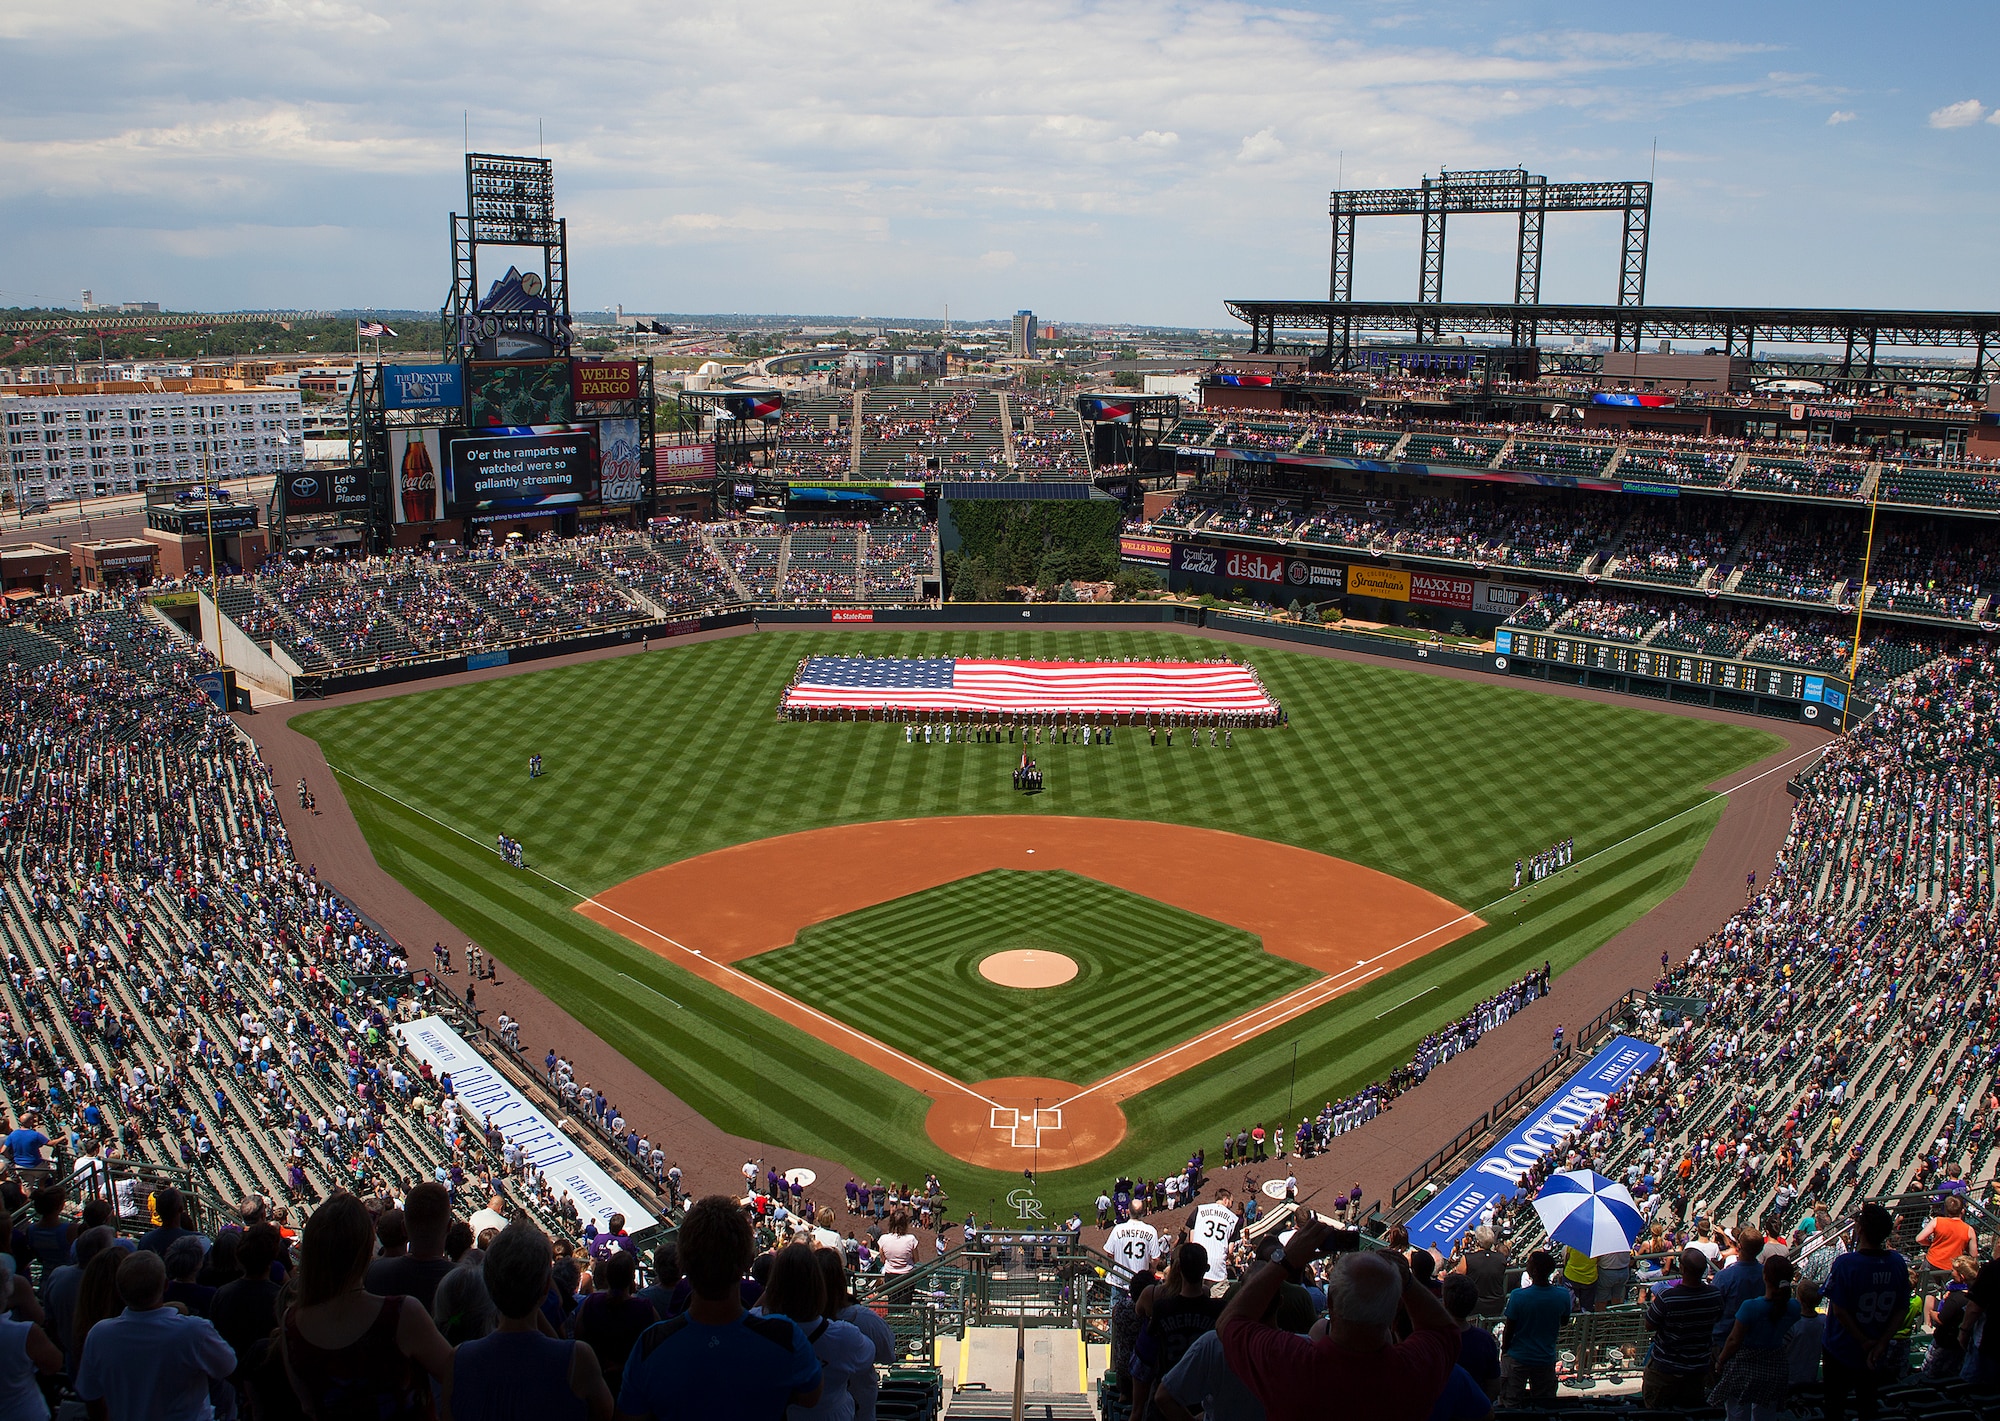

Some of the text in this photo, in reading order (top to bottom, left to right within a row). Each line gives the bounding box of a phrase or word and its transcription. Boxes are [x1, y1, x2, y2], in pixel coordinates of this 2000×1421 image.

[458, 313, 574, 347] ROCKIES
[1360, 352, 1476, 370] THE ROOFTOP
[394, 372, 453, 384] THE DENVER
[581, 368, 630, 380] WELLS
[401, 382, 442, 398] POST
[581, 382, 630, 394] FARGO
[1807, 407, 1852, 419] TAVERN
[467, 446, 577, 461] O'er the ramparts we
[667, 448, 704, 465] KING
[480, 461, 566, 474] watched were so
[334, 475, 356, 484] Let's
[475, 473, 572, 492] gallantly streaming
[189, 492, 217, 500] TOYOTA
[334, 485, 348, 494] Go
[602, 481, 642, 500] LIGHT
[1623, 483, 1678, 494] OfficeLiquidators.com
[289, 498, 321, 506] TOYOTA
[335, 494, 366, 503] Places
[1121, 542, 1171, 554] WELLS FARGO
[1183, 548, 1213, 562] Comfort
[103, 555, 151, 566] FROZEN YOGURT
[1181, 559, 1217, 575] dental
[1227, 554, 1268, 579] dish
[1310, 566, 1342, 577] JIMMY
[1367, 571, 1397, 581] COLORADO
[1309, 575, 1341, 587] JOHN'S
[1351, 572, 1404, 591] Stranahan's
[1412, 576, 1472, 594] MAXX HD
[1412, 588, 1470, 601] sunglasses
[1490, 588, 1519, 604] weber
[1475, 603, 1496, 613] SAUCES
[418, 1031, 456, 1062] WELCOME TO
[1599, 1049, 1640, 1082] SINCE 1993
[450, 1065, 574, 1168] COORS FIELD
[1476, 1085, 1610, 1185] ROCKIES
[565, 1175, 618, 1219] DENVER, CO
[1200, 1209, 1235, 1226] BUCHHOLZ
[1434, 1191, 1485, 1233] COLORADO
[1116, 1230, 1154, 1242] LANSFORD
[1204, 1220, 1226, 1240] 35
[1124, 1241, 1146, 1260] 43
[1873, 1272, 1891, 1285] RYU
[1856, 1291, 1896, 1324] 99
